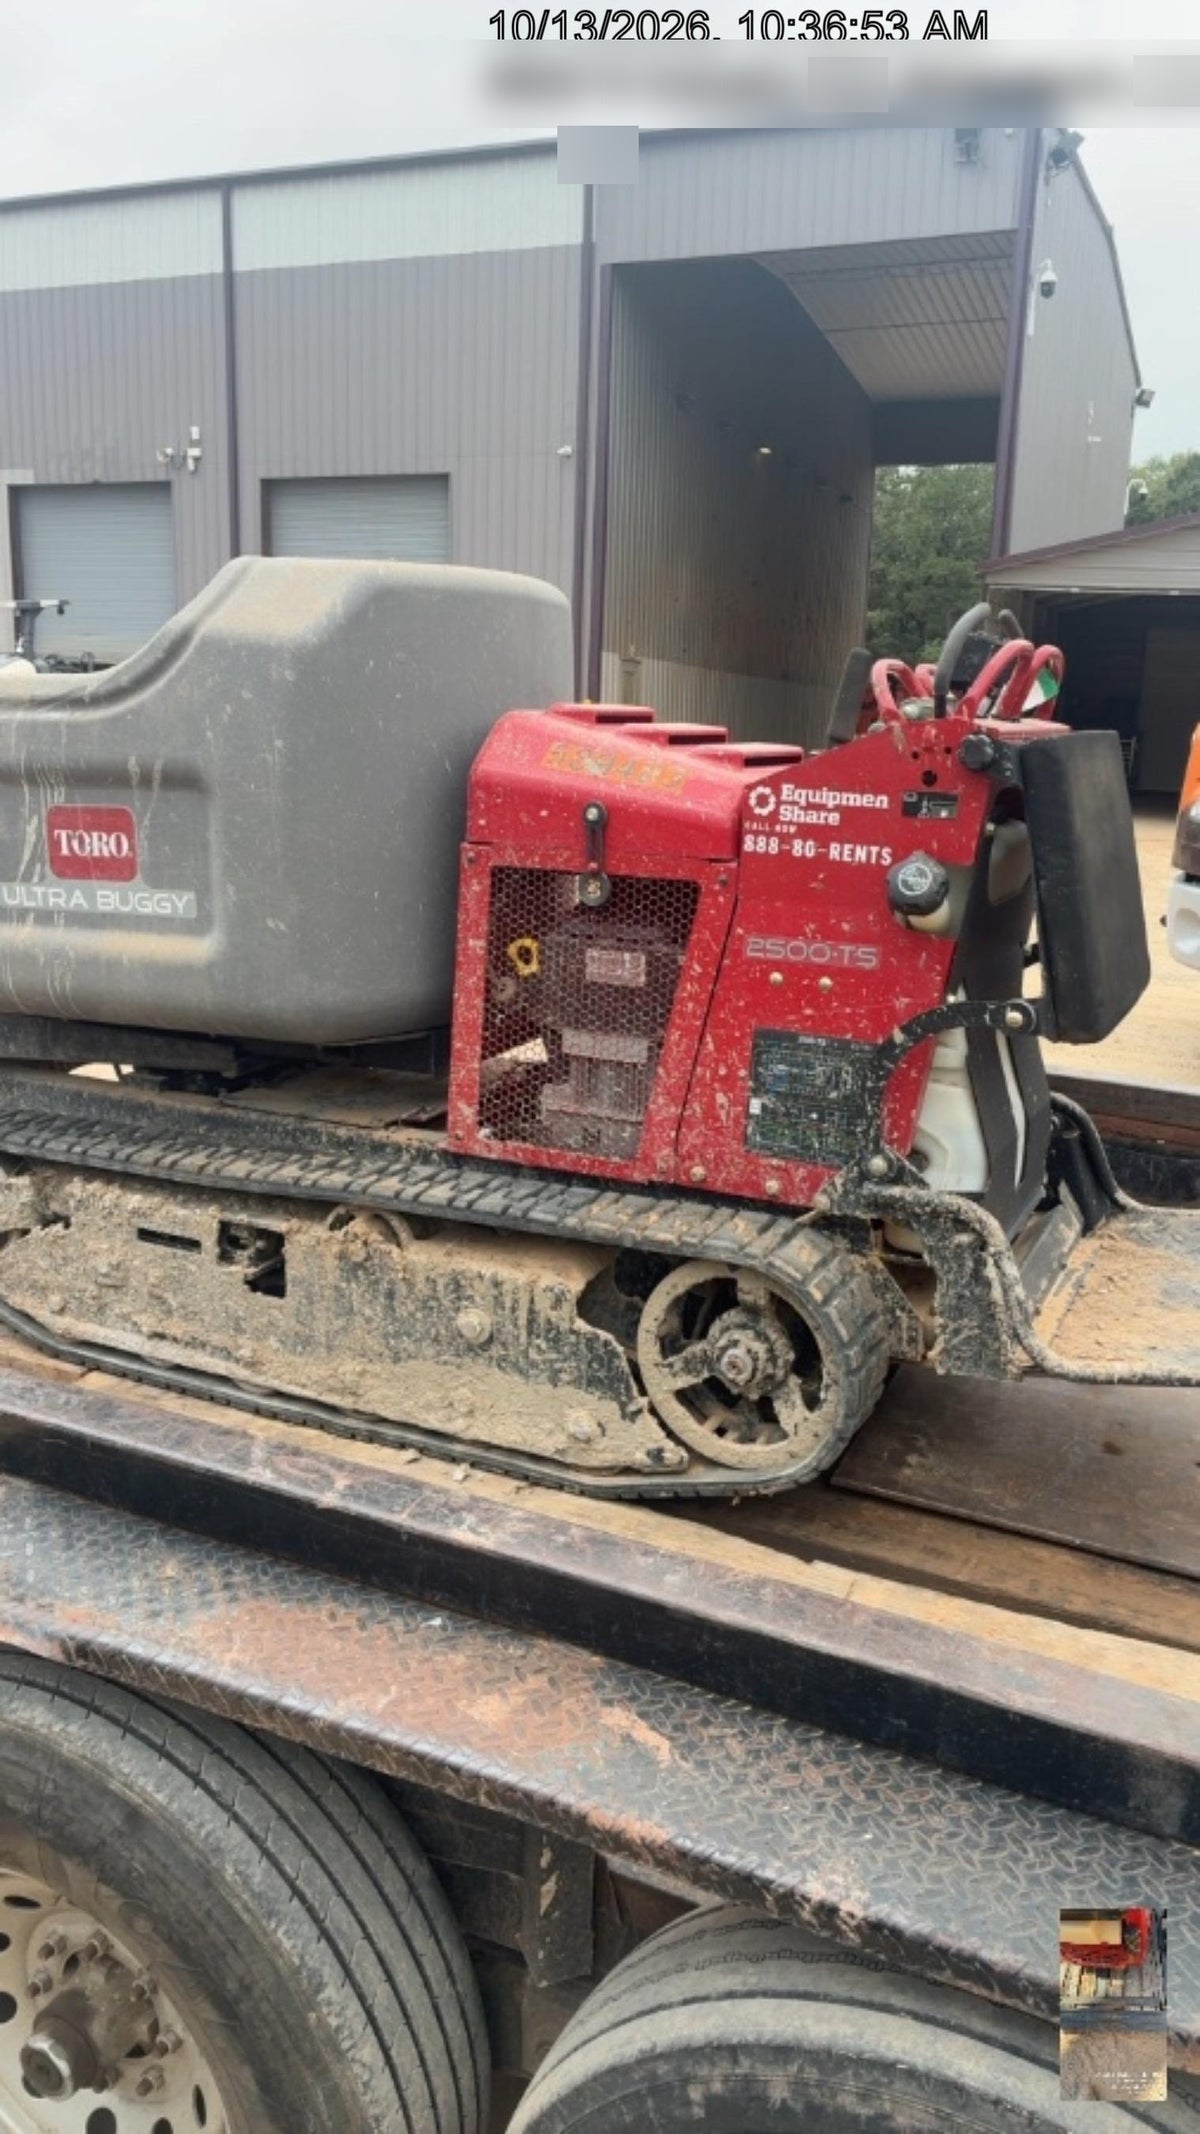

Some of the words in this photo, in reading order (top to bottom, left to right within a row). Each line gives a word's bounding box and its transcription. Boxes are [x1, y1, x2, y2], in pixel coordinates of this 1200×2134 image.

[779, 804, 840, 825] Share
[54, 829, 130, 858] TORO
[743, 834, 893, 866] 888-80-RENTS
[2, 885, 89, 910] ULTRA
[97, 890, 190, 914] BUGGY
